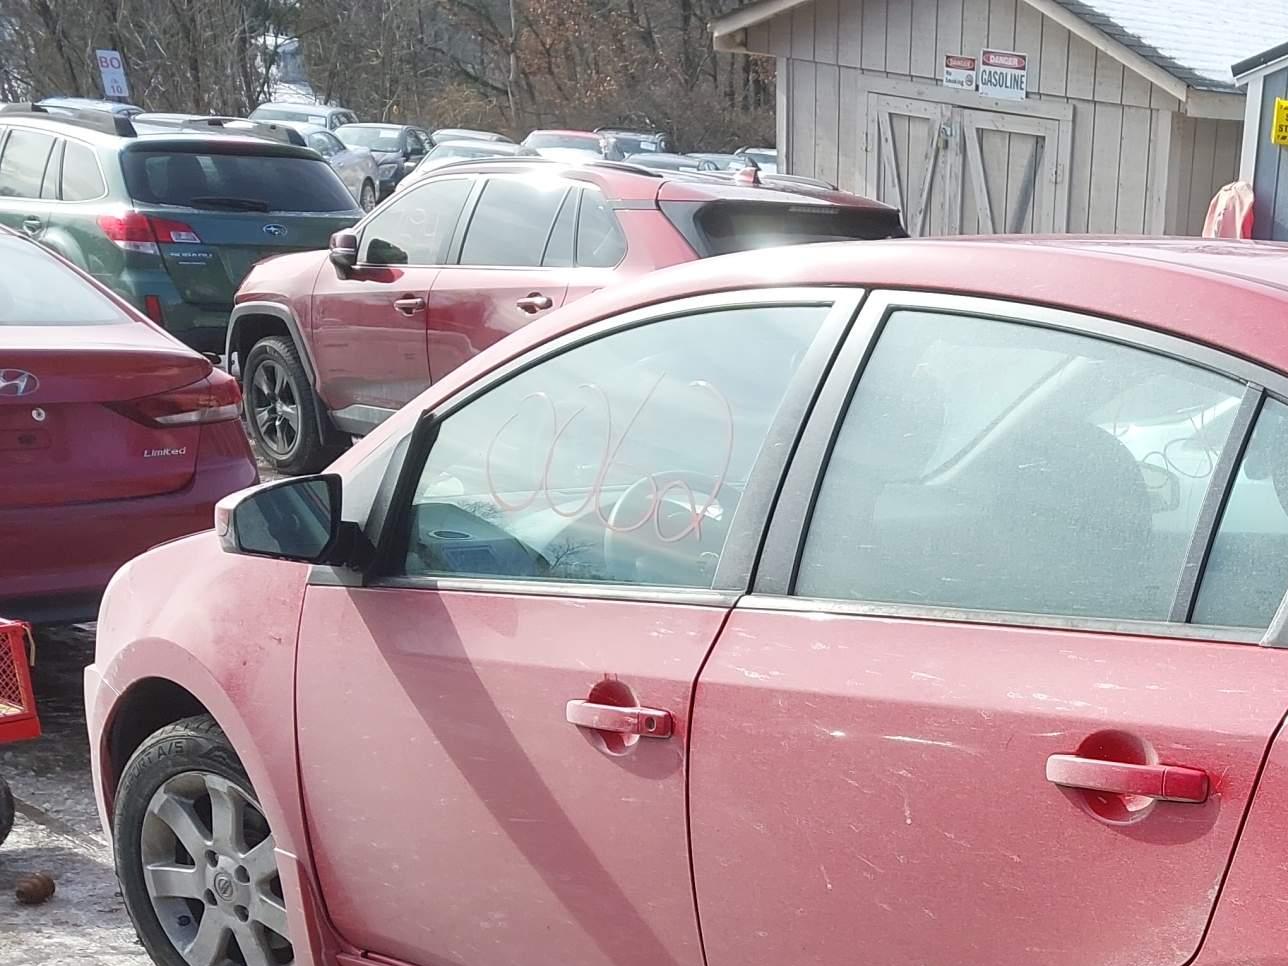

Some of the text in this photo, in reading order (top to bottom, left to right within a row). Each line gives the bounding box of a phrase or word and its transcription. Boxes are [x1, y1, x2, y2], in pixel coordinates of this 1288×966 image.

[989, 55, 1018, 67] DANGER
[981, 69, 1025, 91] GASOLINE
[143, 447, 186, 458] Limited
